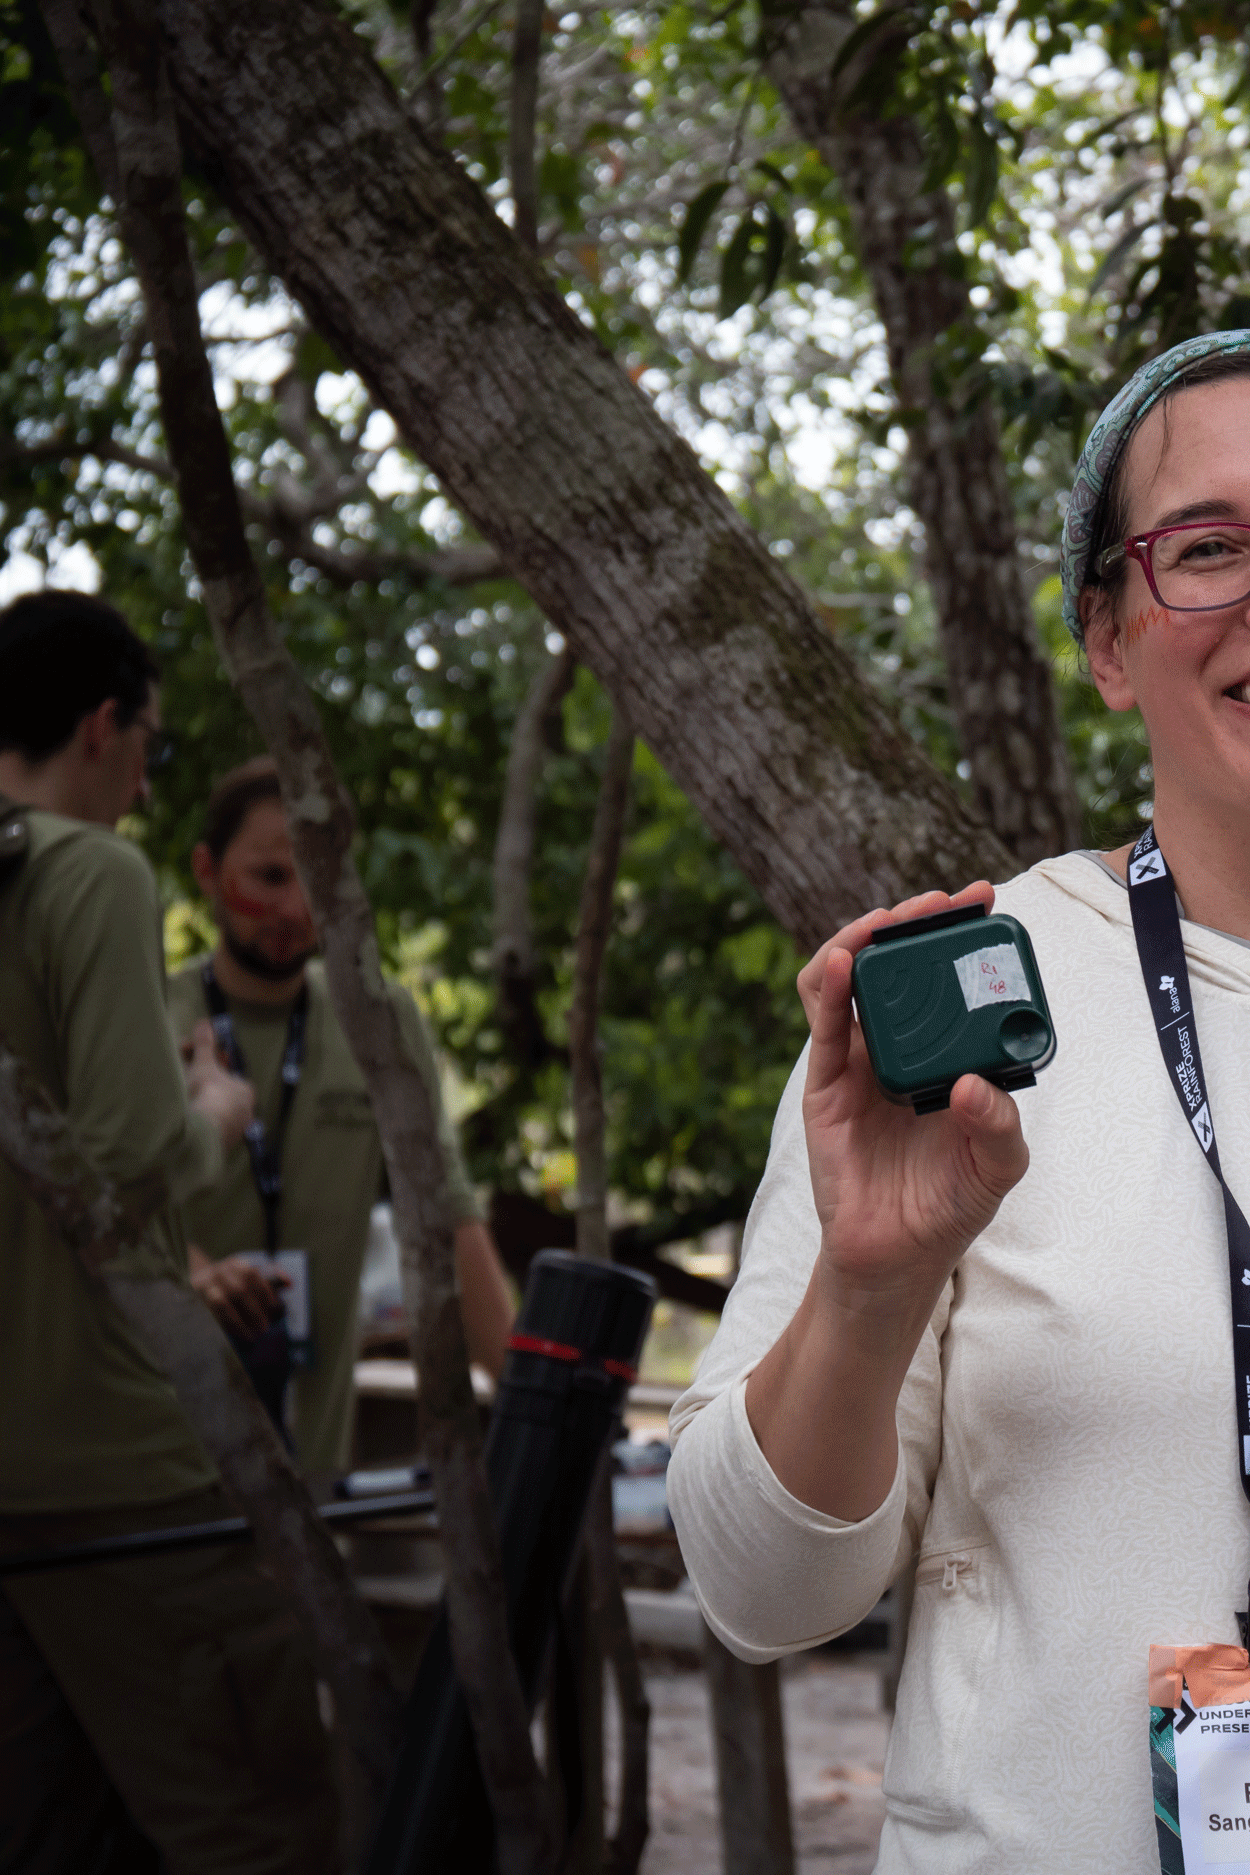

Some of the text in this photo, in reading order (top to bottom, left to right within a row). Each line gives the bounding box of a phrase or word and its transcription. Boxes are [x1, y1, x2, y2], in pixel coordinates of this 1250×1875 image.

[989, 980, 1006, 994] 48
[1168, 987, 1181, 1014] alana
[1177, 1025, 1203, 1104] RAINFOREST
[1176, 1061, 1198, 1112] XPRIZE
